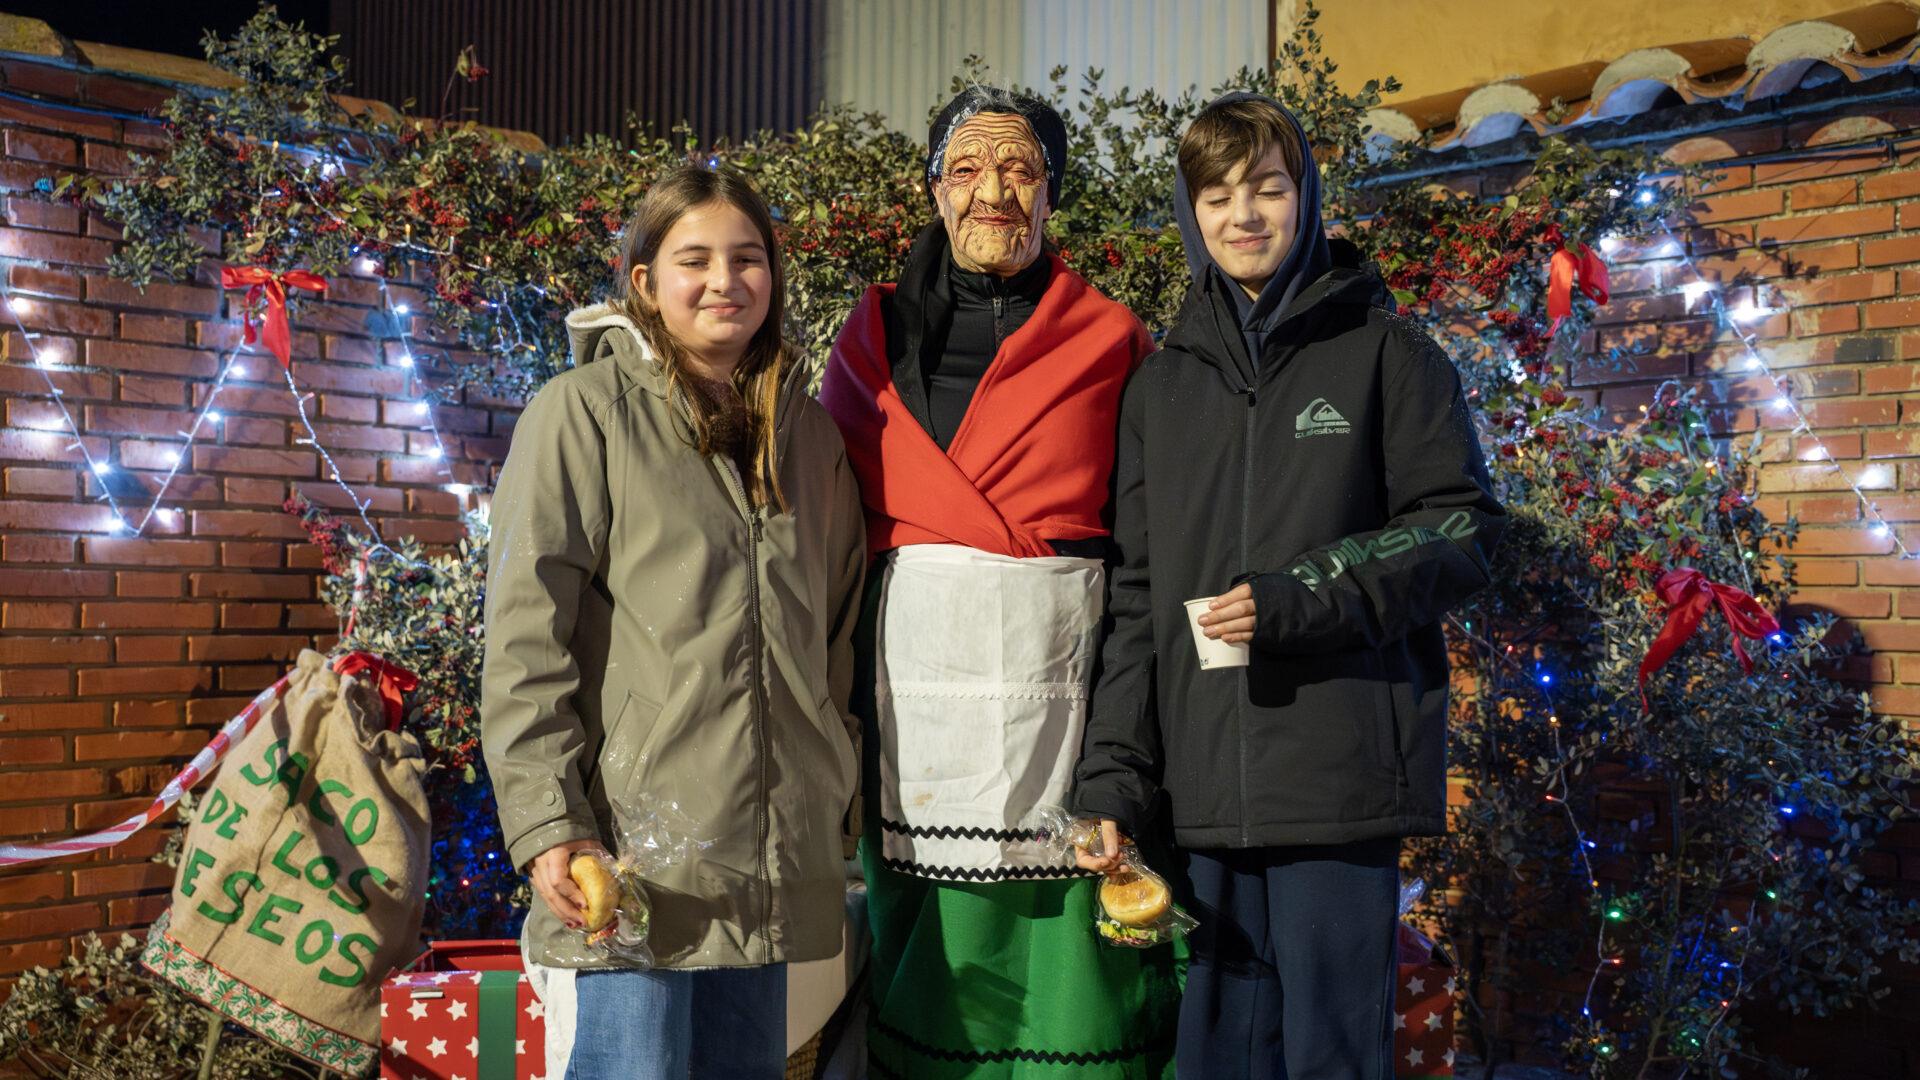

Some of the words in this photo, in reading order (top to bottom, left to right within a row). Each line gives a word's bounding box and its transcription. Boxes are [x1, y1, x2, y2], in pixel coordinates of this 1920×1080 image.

[1295, 427, 1351, 439] QUSILVER
[240, 738, 379, 846] SACO
[202, 788, 248, 840] DE
[272, 831, 389, 915] LOS
[181, 848, 378, 988] ESEOS
